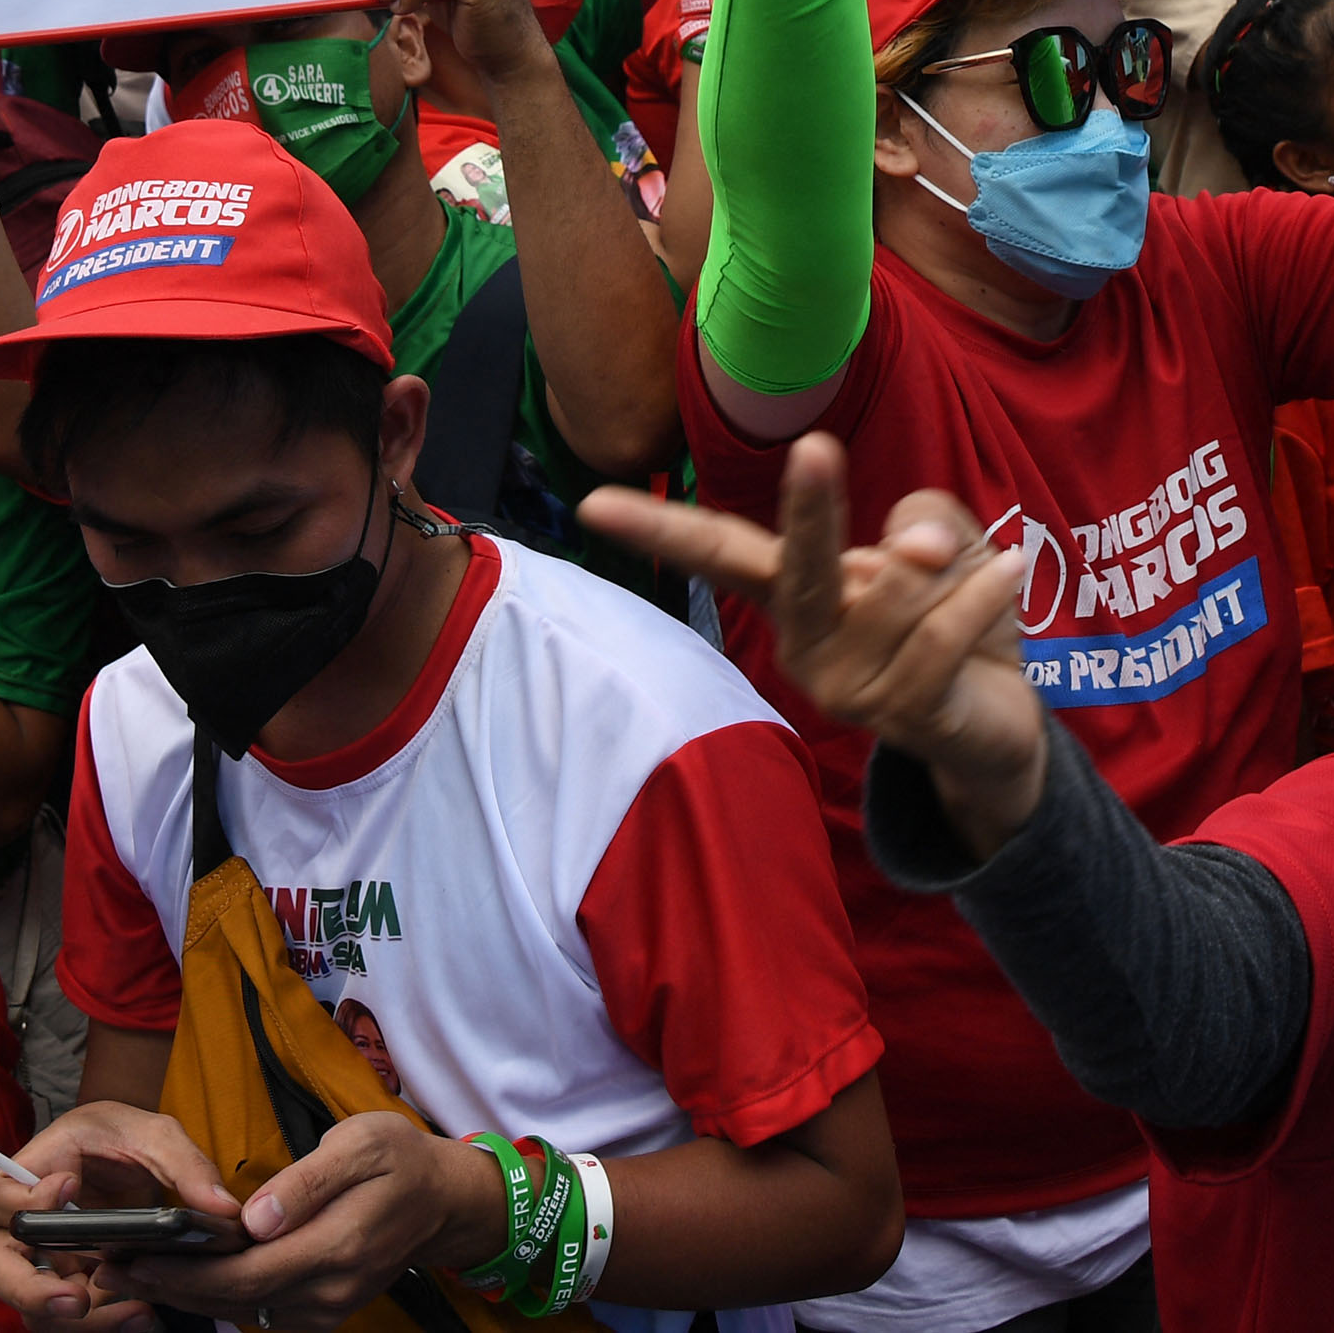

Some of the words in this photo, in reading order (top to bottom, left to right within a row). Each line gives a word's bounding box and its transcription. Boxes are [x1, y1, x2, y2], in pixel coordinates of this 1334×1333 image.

[288, 63, 325, 84] SARA
[289, 83, 347, 106] DUTERTE
[287, 127, 311, 142] VICE
[89, 180, 254, 219] BONGBONG
[80, 199, 248, 248] MARCOS
[42, 275, 63, 299] FOR
[509, 1165, 530, 1239] ERTE
[526, 1246, 543, 1264] FOR
[542, 1217, 557, 1244] VICE
[554, 1177, 572, 1224] PRESIDENT
[528, 1195, 551, 1236] SARA
[534, 1172, 566, 1240] DUTERTE
[547, 1241, 581, 1316] DUTER
